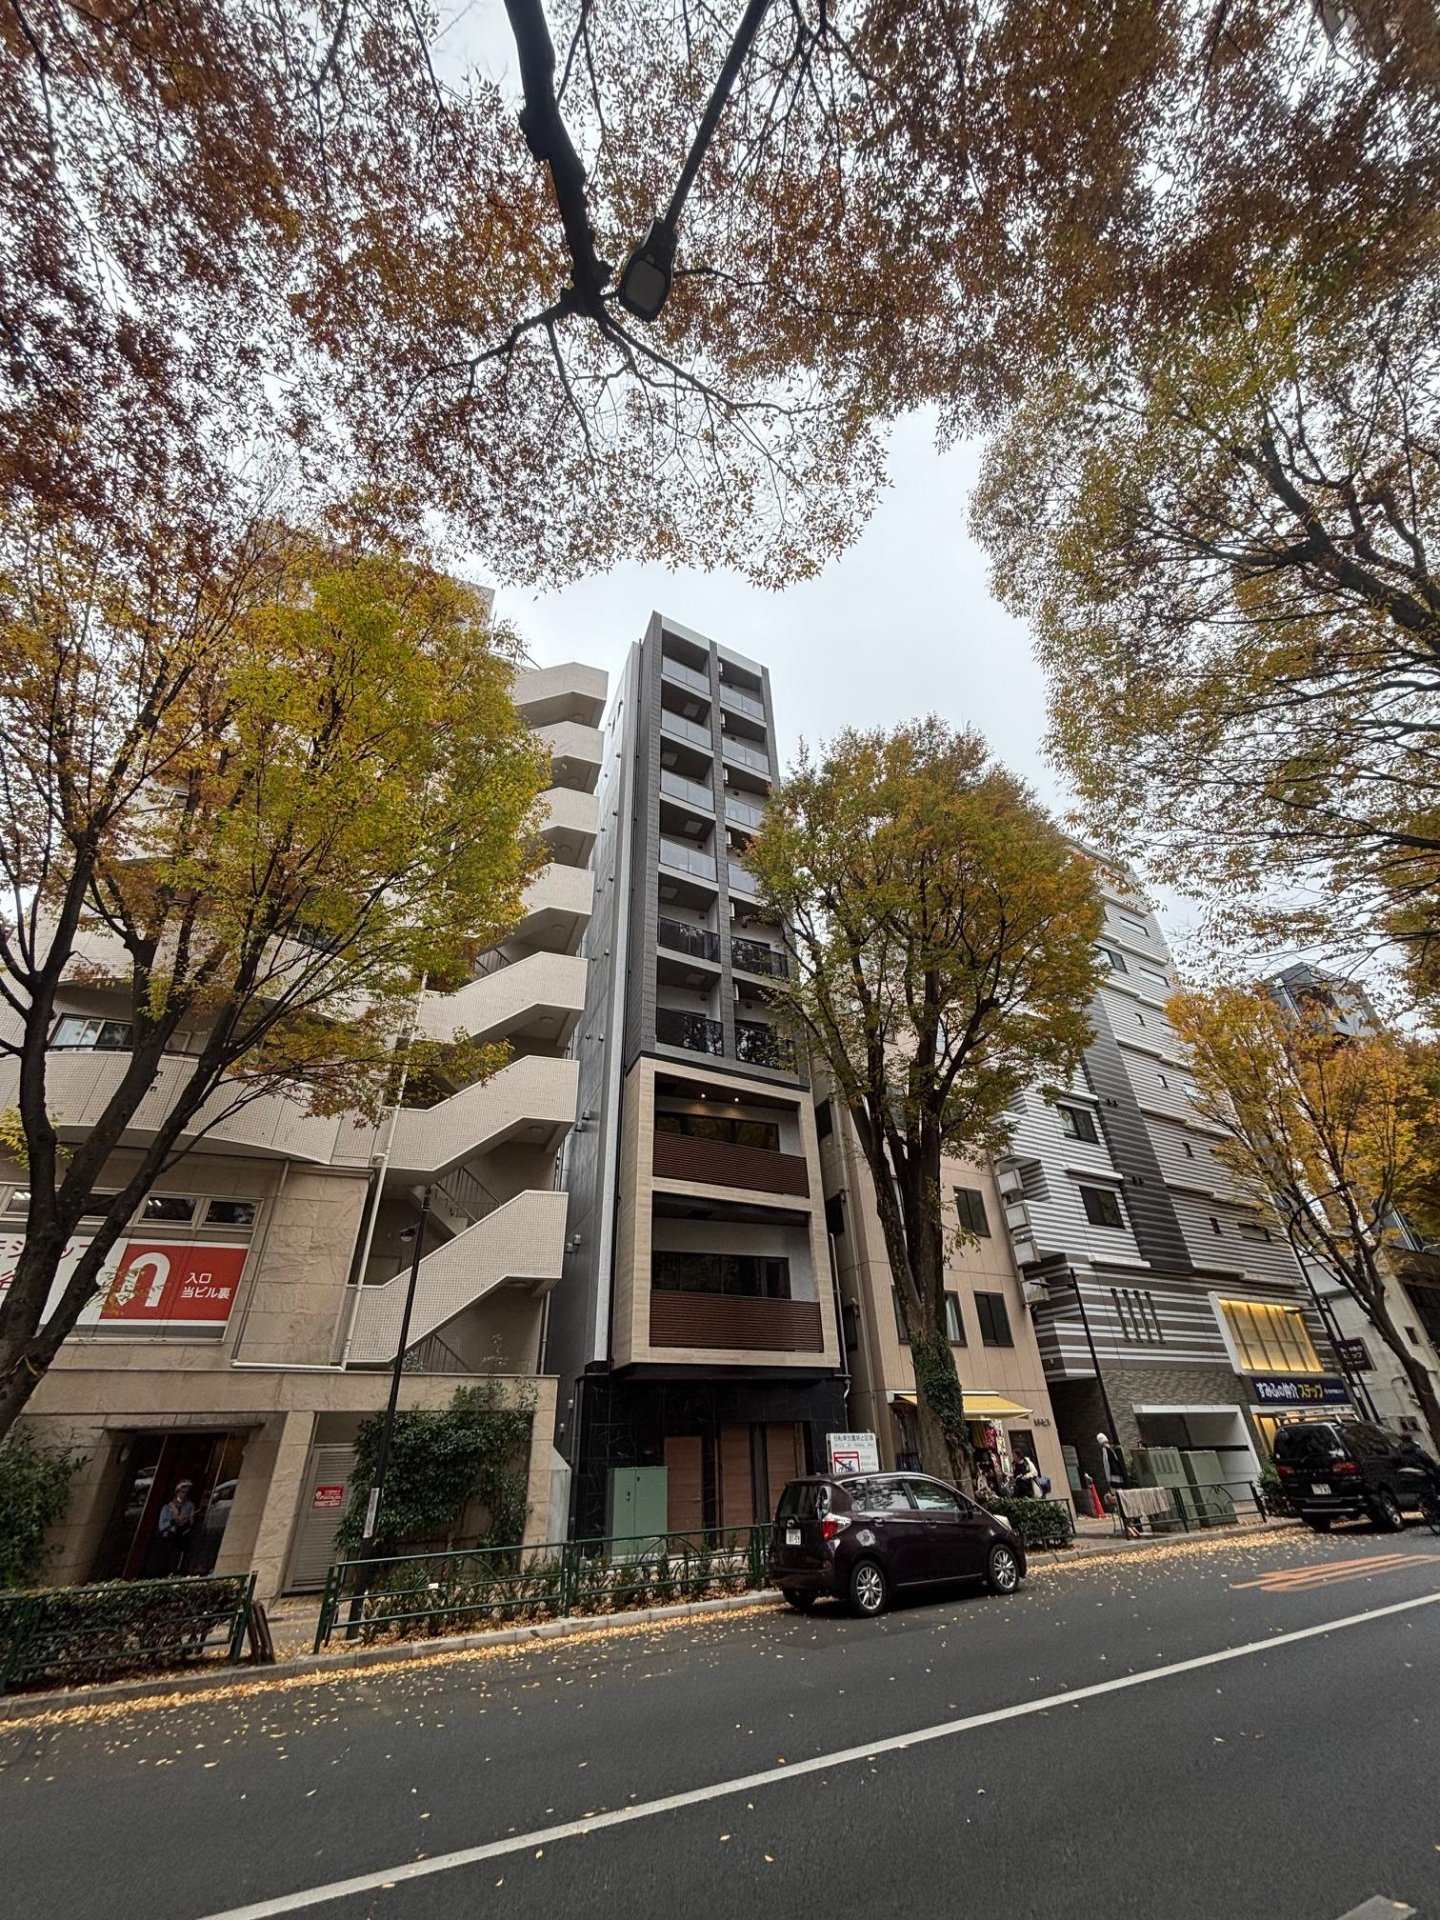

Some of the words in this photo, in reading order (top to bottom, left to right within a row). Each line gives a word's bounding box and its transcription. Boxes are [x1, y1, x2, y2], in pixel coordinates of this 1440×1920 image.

[185, 1272, 212, 1284] 入口
[181, 1286, 232, 1300] 当ビル裏
[1297, 1383, 1324, 1399] ステップ
